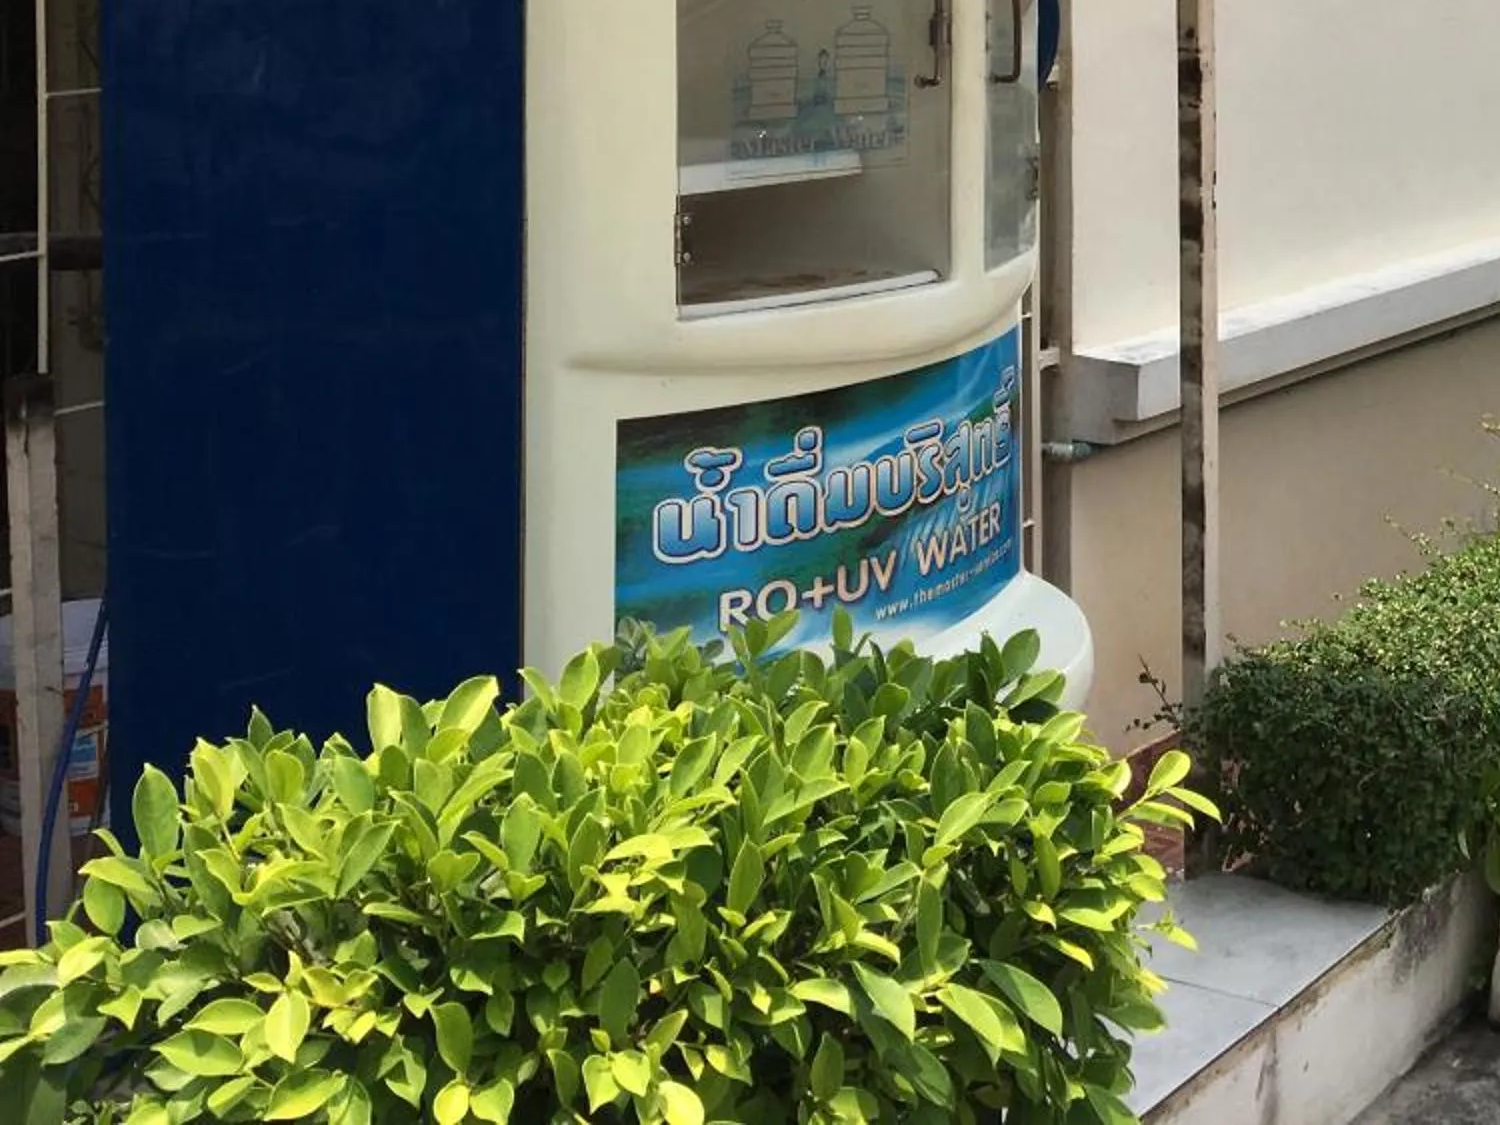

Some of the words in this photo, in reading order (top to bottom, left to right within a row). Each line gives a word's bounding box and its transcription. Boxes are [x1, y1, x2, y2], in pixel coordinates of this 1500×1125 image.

[652, 363, 1016, 564] น้ำดื่มบริสุทธิ์
[717, 549, 897, 635] RO+UV
[914, 501, 1001, 576] WATER
